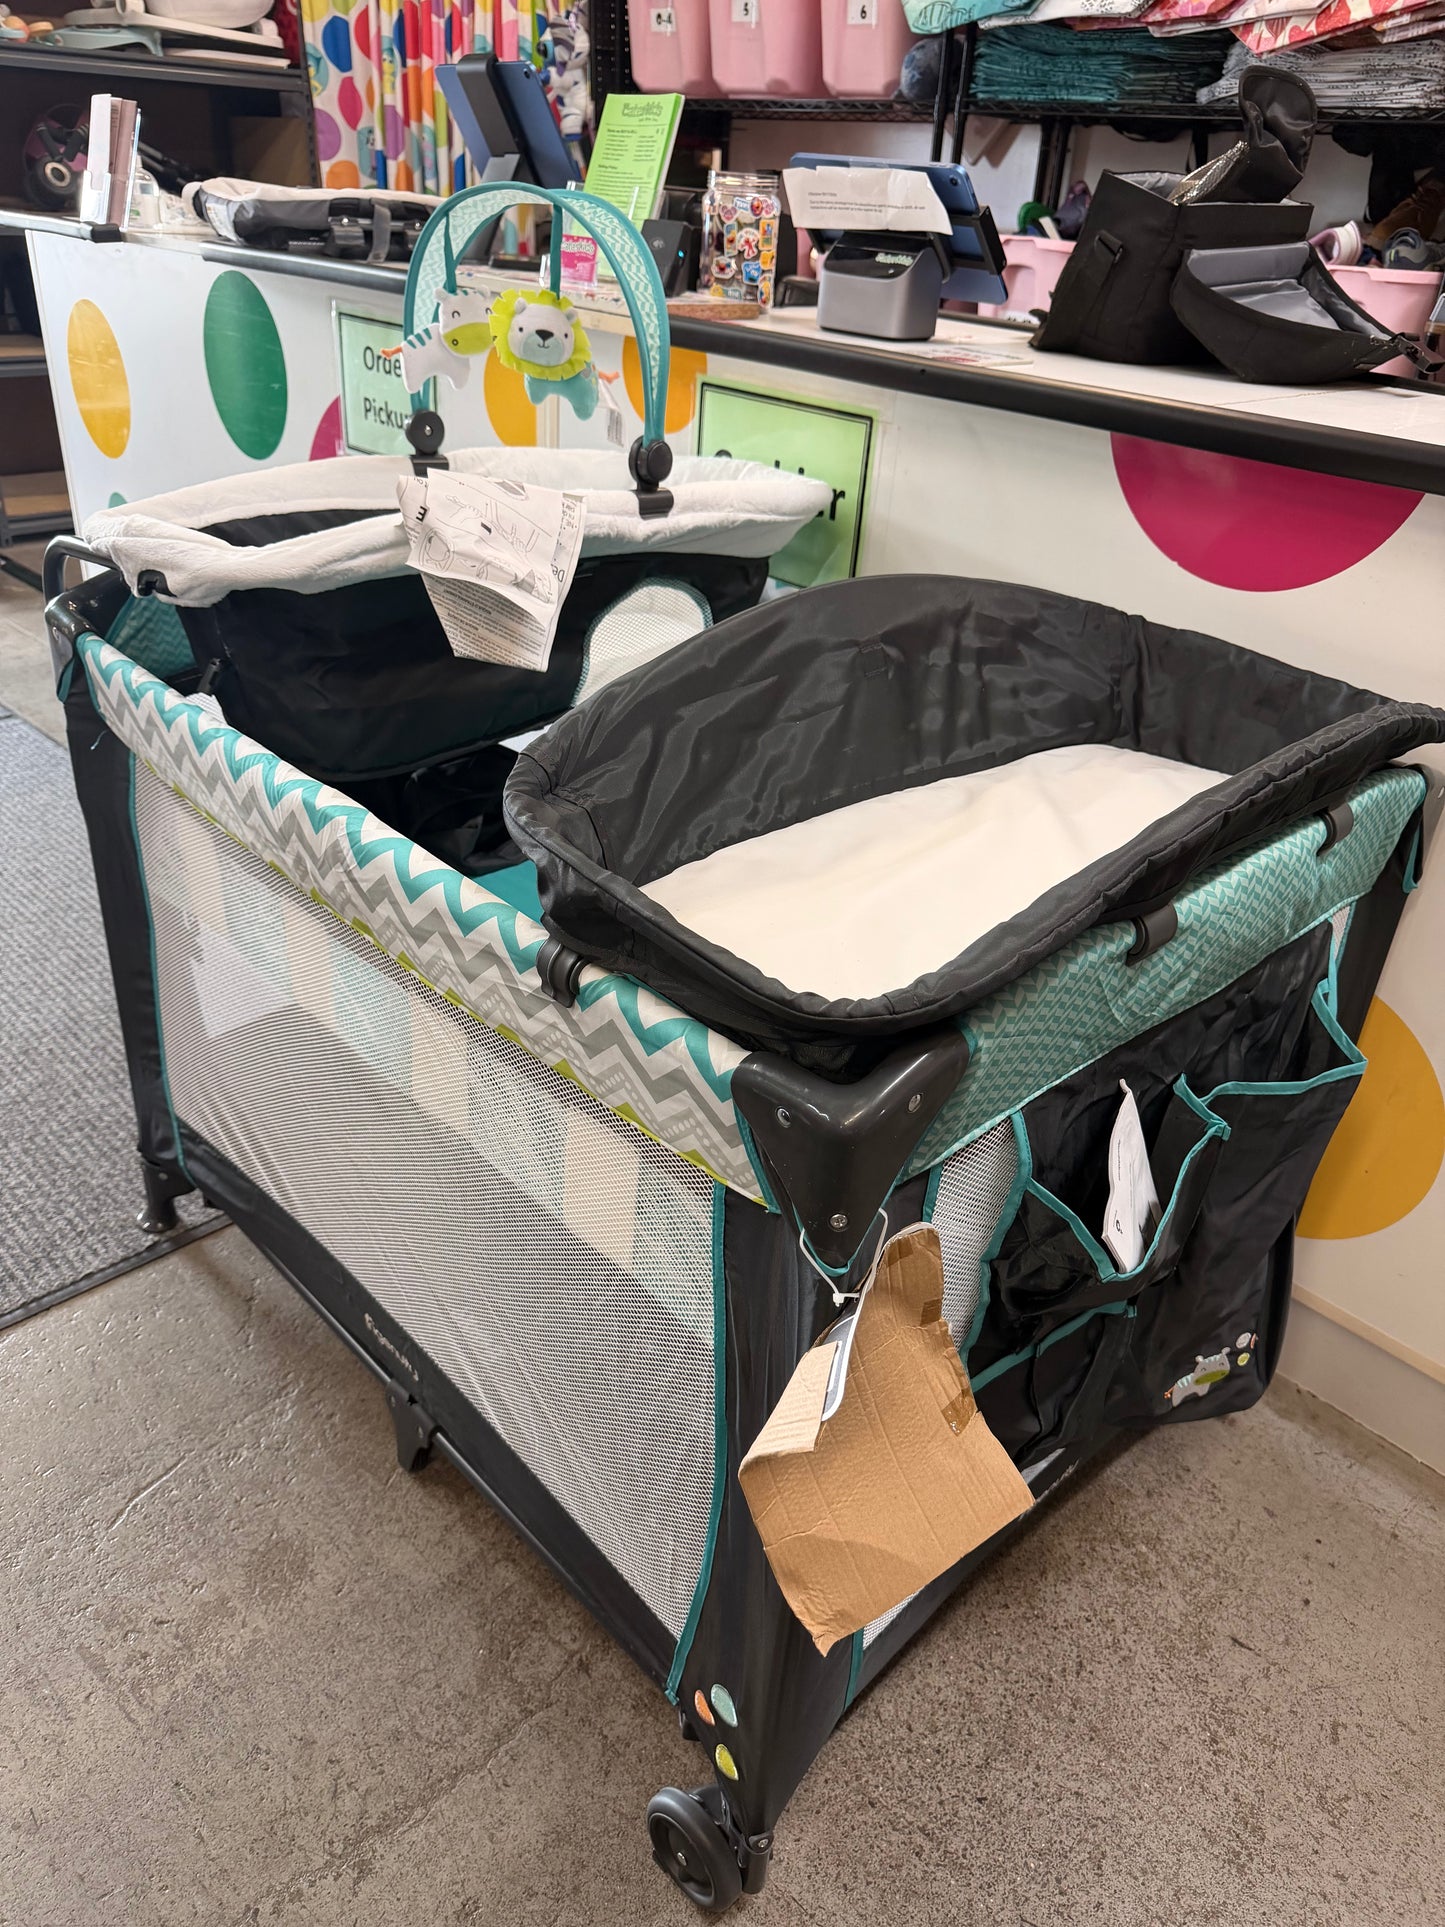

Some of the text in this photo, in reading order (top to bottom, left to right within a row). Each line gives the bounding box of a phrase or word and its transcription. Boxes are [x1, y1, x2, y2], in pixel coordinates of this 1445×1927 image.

[743, 2, 749, 16] 5
[860, 4, 867, 19] 6
[363, 345, 402, 377] Orde
[363, 397, 411, 429] Picku
